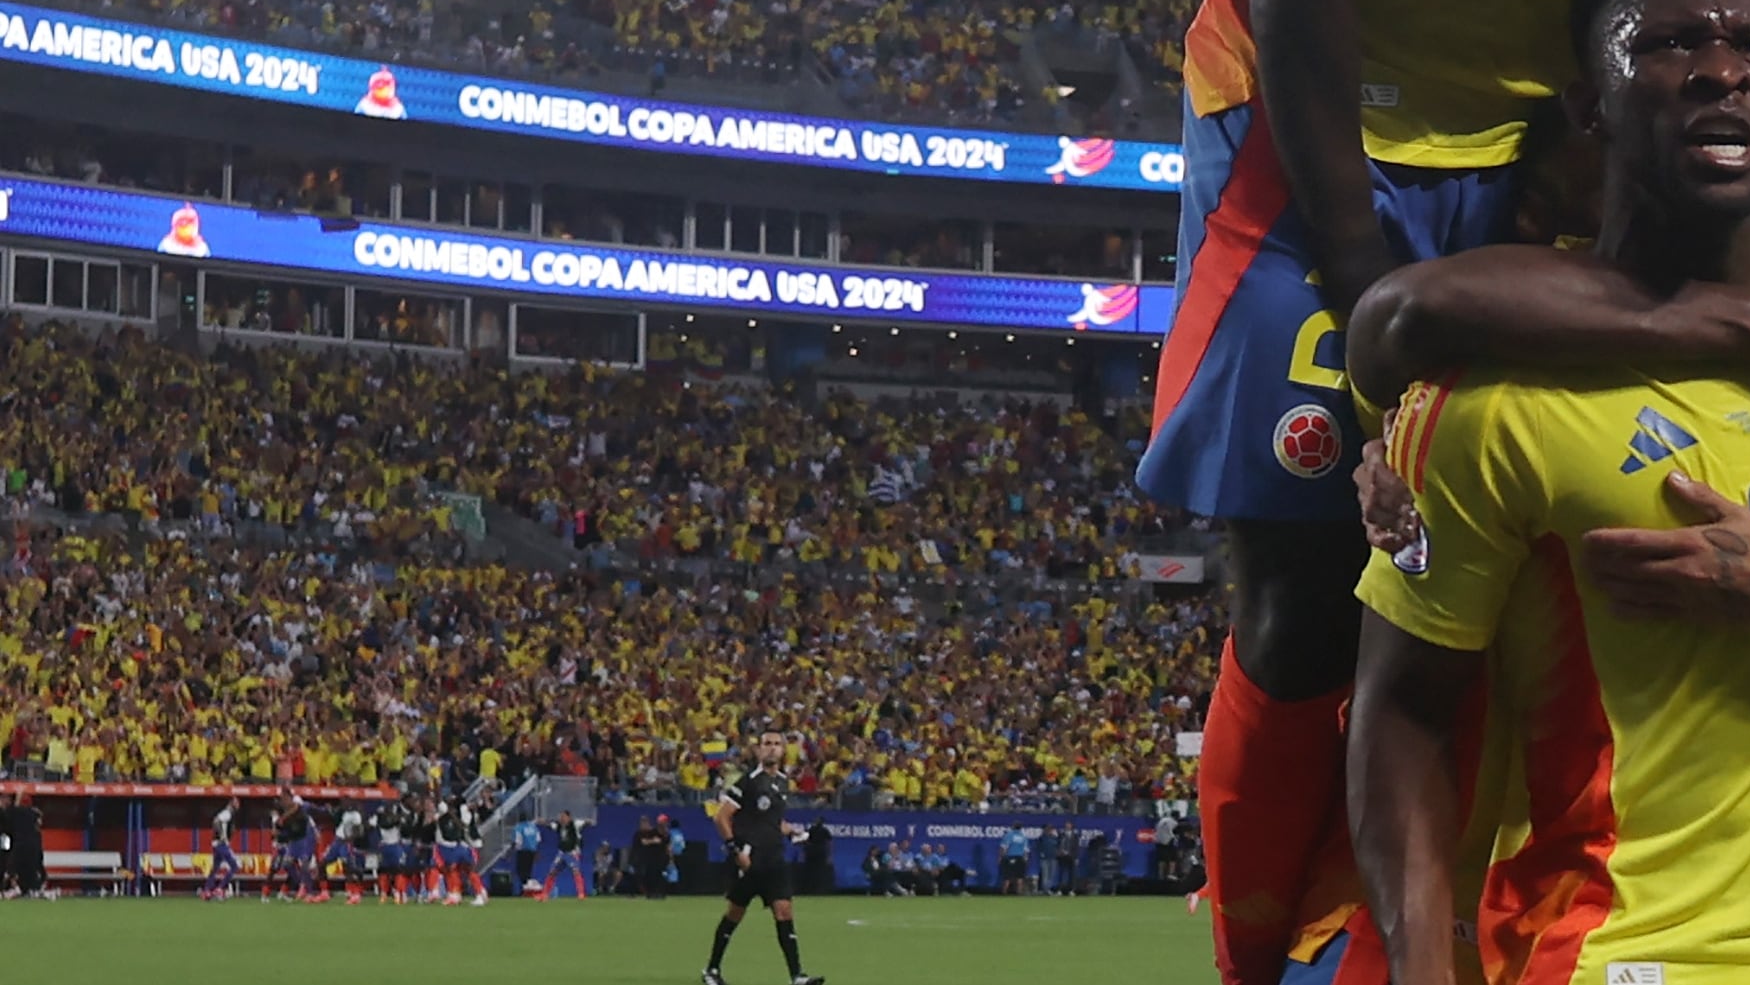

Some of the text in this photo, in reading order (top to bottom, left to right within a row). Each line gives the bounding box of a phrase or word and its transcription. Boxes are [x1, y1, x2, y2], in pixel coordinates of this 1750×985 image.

[30, 20, 175, 73] AMERICA
[181, 42, 242, 85] USA
[245, 53, 319, 94] 2024
[459, 85, 1005, 171] CONMEBOL COPA AMERICA USA 2024
[354, 230, 925, 312] CONMEBOL COPA AMERICA USA 2024
[927, 825, 984, 838] CONMEBOL
